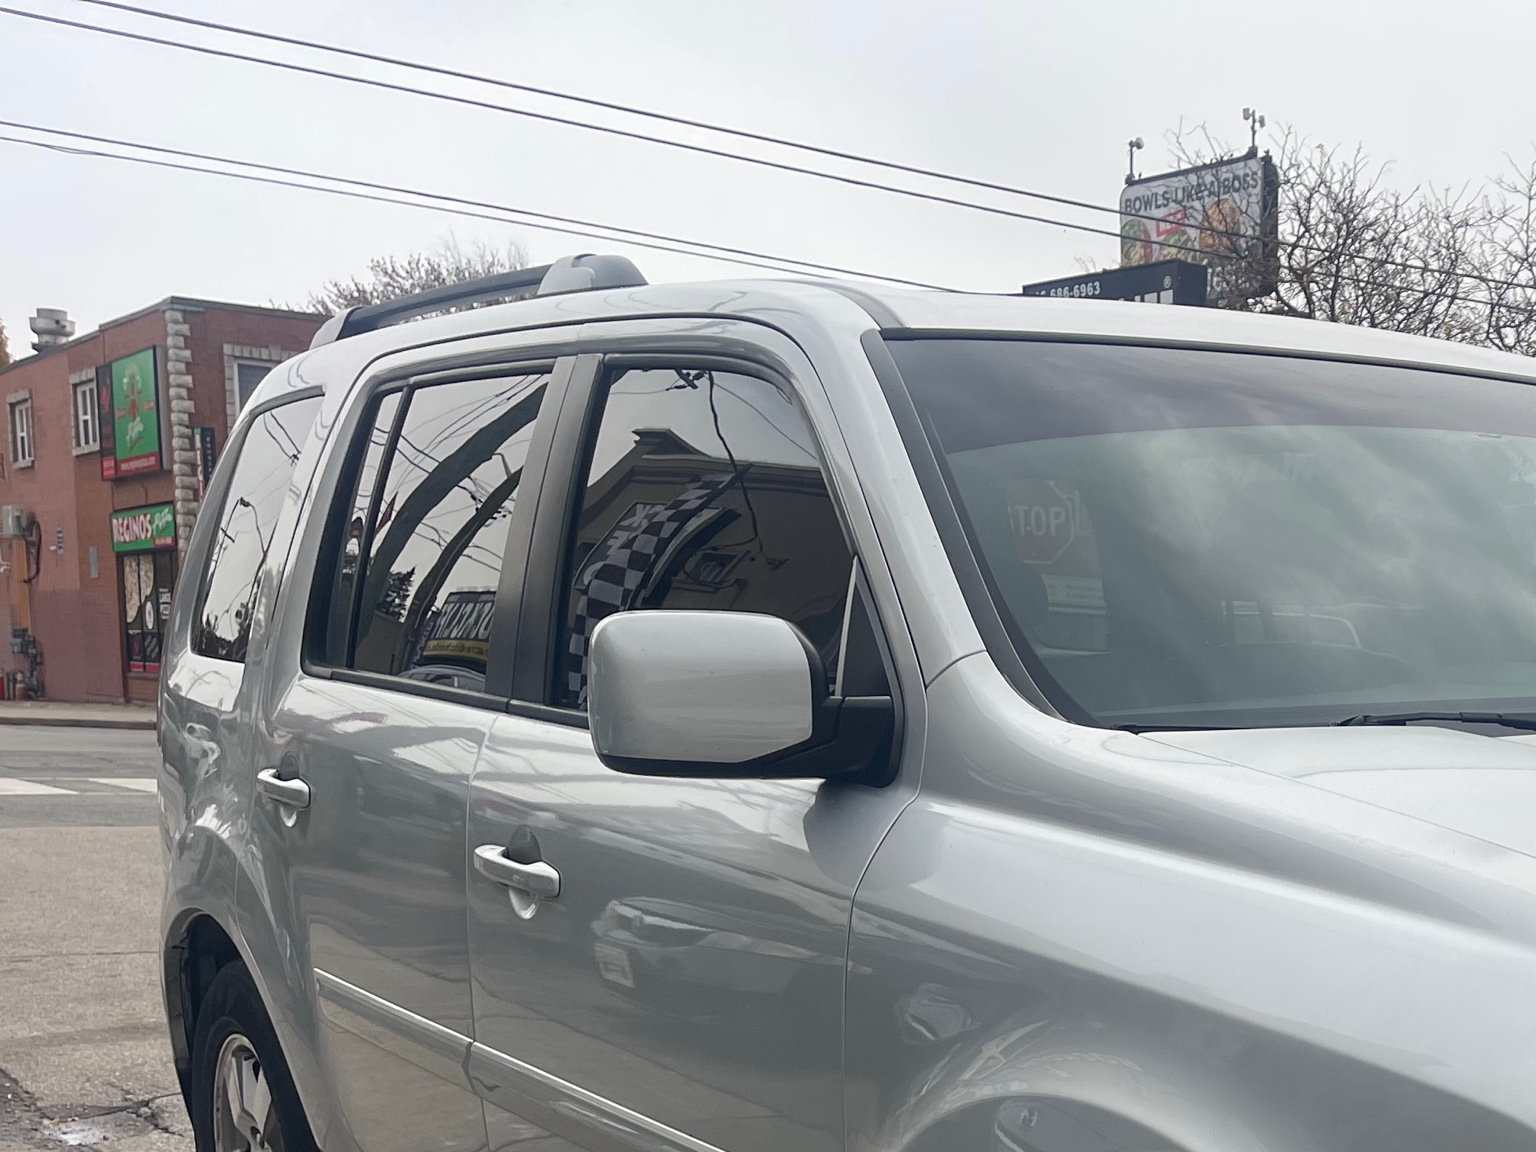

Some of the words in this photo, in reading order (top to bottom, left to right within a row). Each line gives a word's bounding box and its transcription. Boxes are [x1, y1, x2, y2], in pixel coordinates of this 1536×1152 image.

[1124, 190, 1170, 213] BOWLS
[1174, 183, 1204, 204] LIKE
[1222, 172, 1258, 195] BOSS
[112, 513, 152, 543] REGINOS
